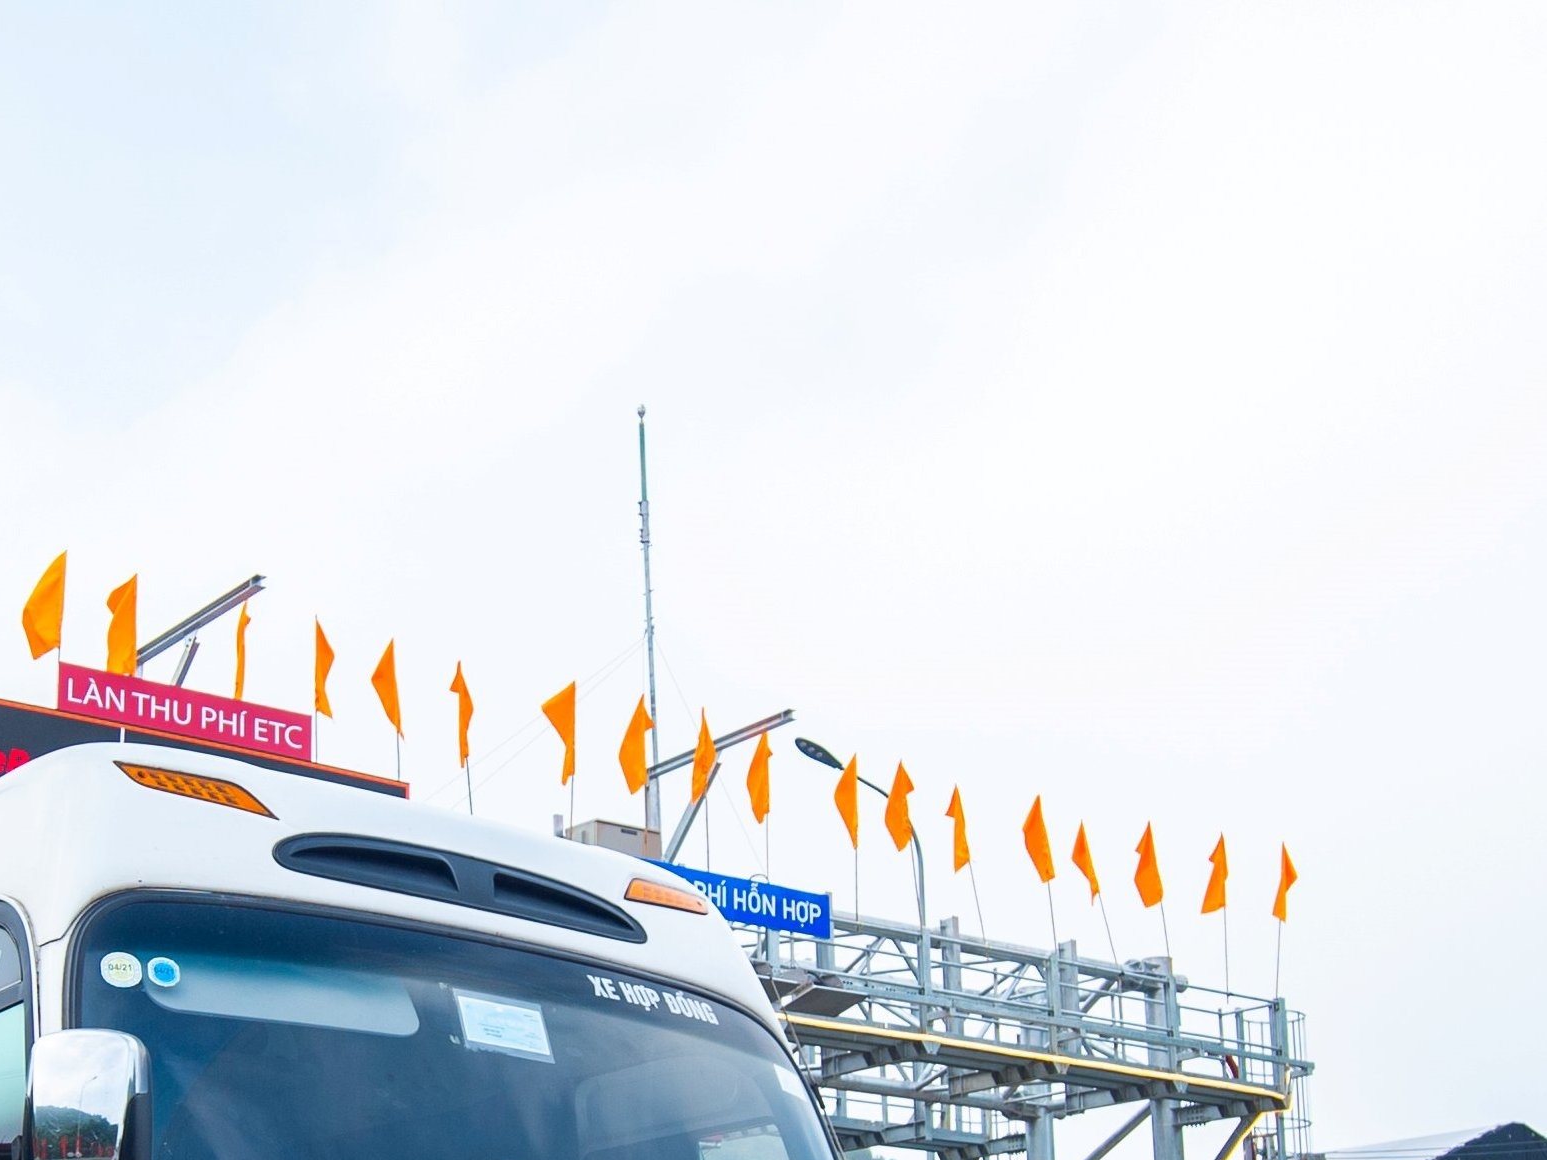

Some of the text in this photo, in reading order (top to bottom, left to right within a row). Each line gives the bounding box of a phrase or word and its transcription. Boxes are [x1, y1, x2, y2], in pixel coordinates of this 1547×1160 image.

[66, 677, 303, 749] LÀN THU PHÍ ETC
[733, 883, 776, 917] HỖN
[783, 898, 822, 927] HỢP
[586, 975, 621, 1001] XE
[618, 982, 660, 1011] HỢP
